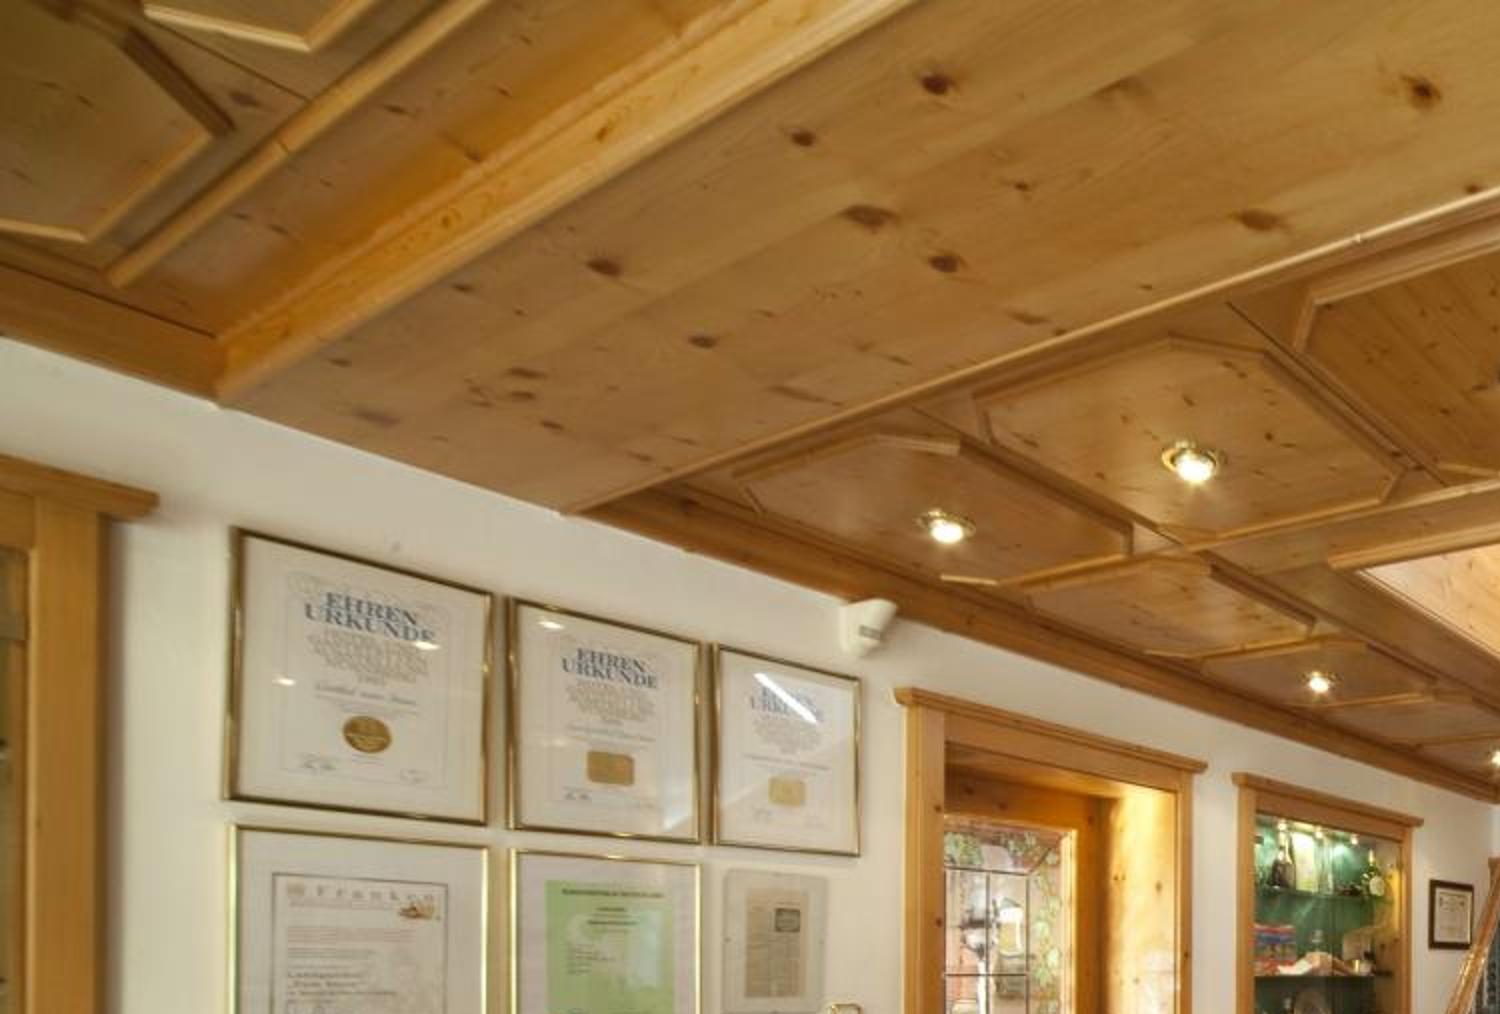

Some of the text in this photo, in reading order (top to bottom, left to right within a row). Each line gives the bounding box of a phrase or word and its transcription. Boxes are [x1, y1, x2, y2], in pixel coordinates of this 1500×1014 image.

[304, 603, 437, 642] URKUNDE
[326, 592, 417, 626] EHREN
[561, 658, 658, 688] URKUNDE
[577, 648, 646, 672] EHREN
